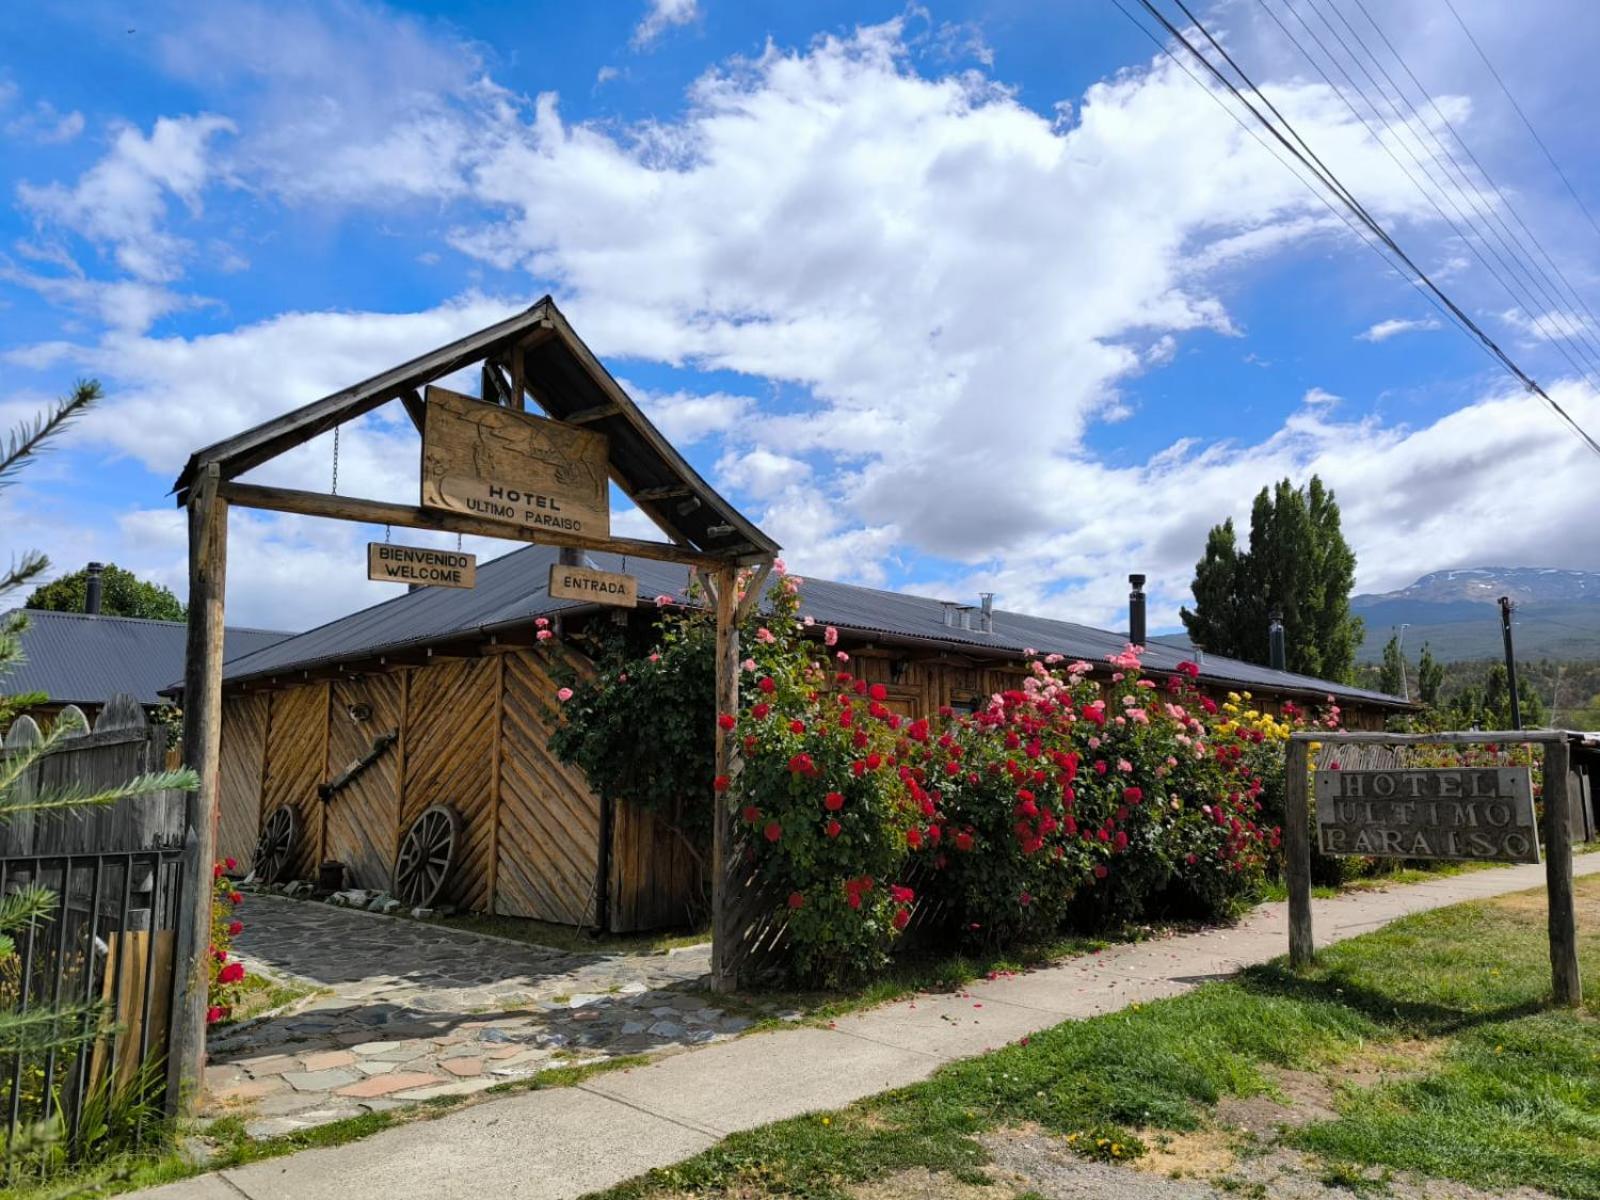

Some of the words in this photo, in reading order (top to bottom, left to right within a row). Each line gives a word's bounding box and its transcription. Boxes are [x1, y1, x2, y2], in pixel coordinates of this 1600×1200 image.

[489, 484, 561, 511] HOTEL
[466, 498, 515, 518] ULTIMO
[525, 511, 581, 531] PARAISO
[380, 547, 468, 568] BIENVENIDO
[385, 563, 462, 582] WELCOME
[564, 576, 626, 595] ENTRADA
[1343, 772, 1497, 798] HOTEL
[1338, 801, 1512, 828] ULTIMO
[1326, 828, 1530, 858] PARAISO
